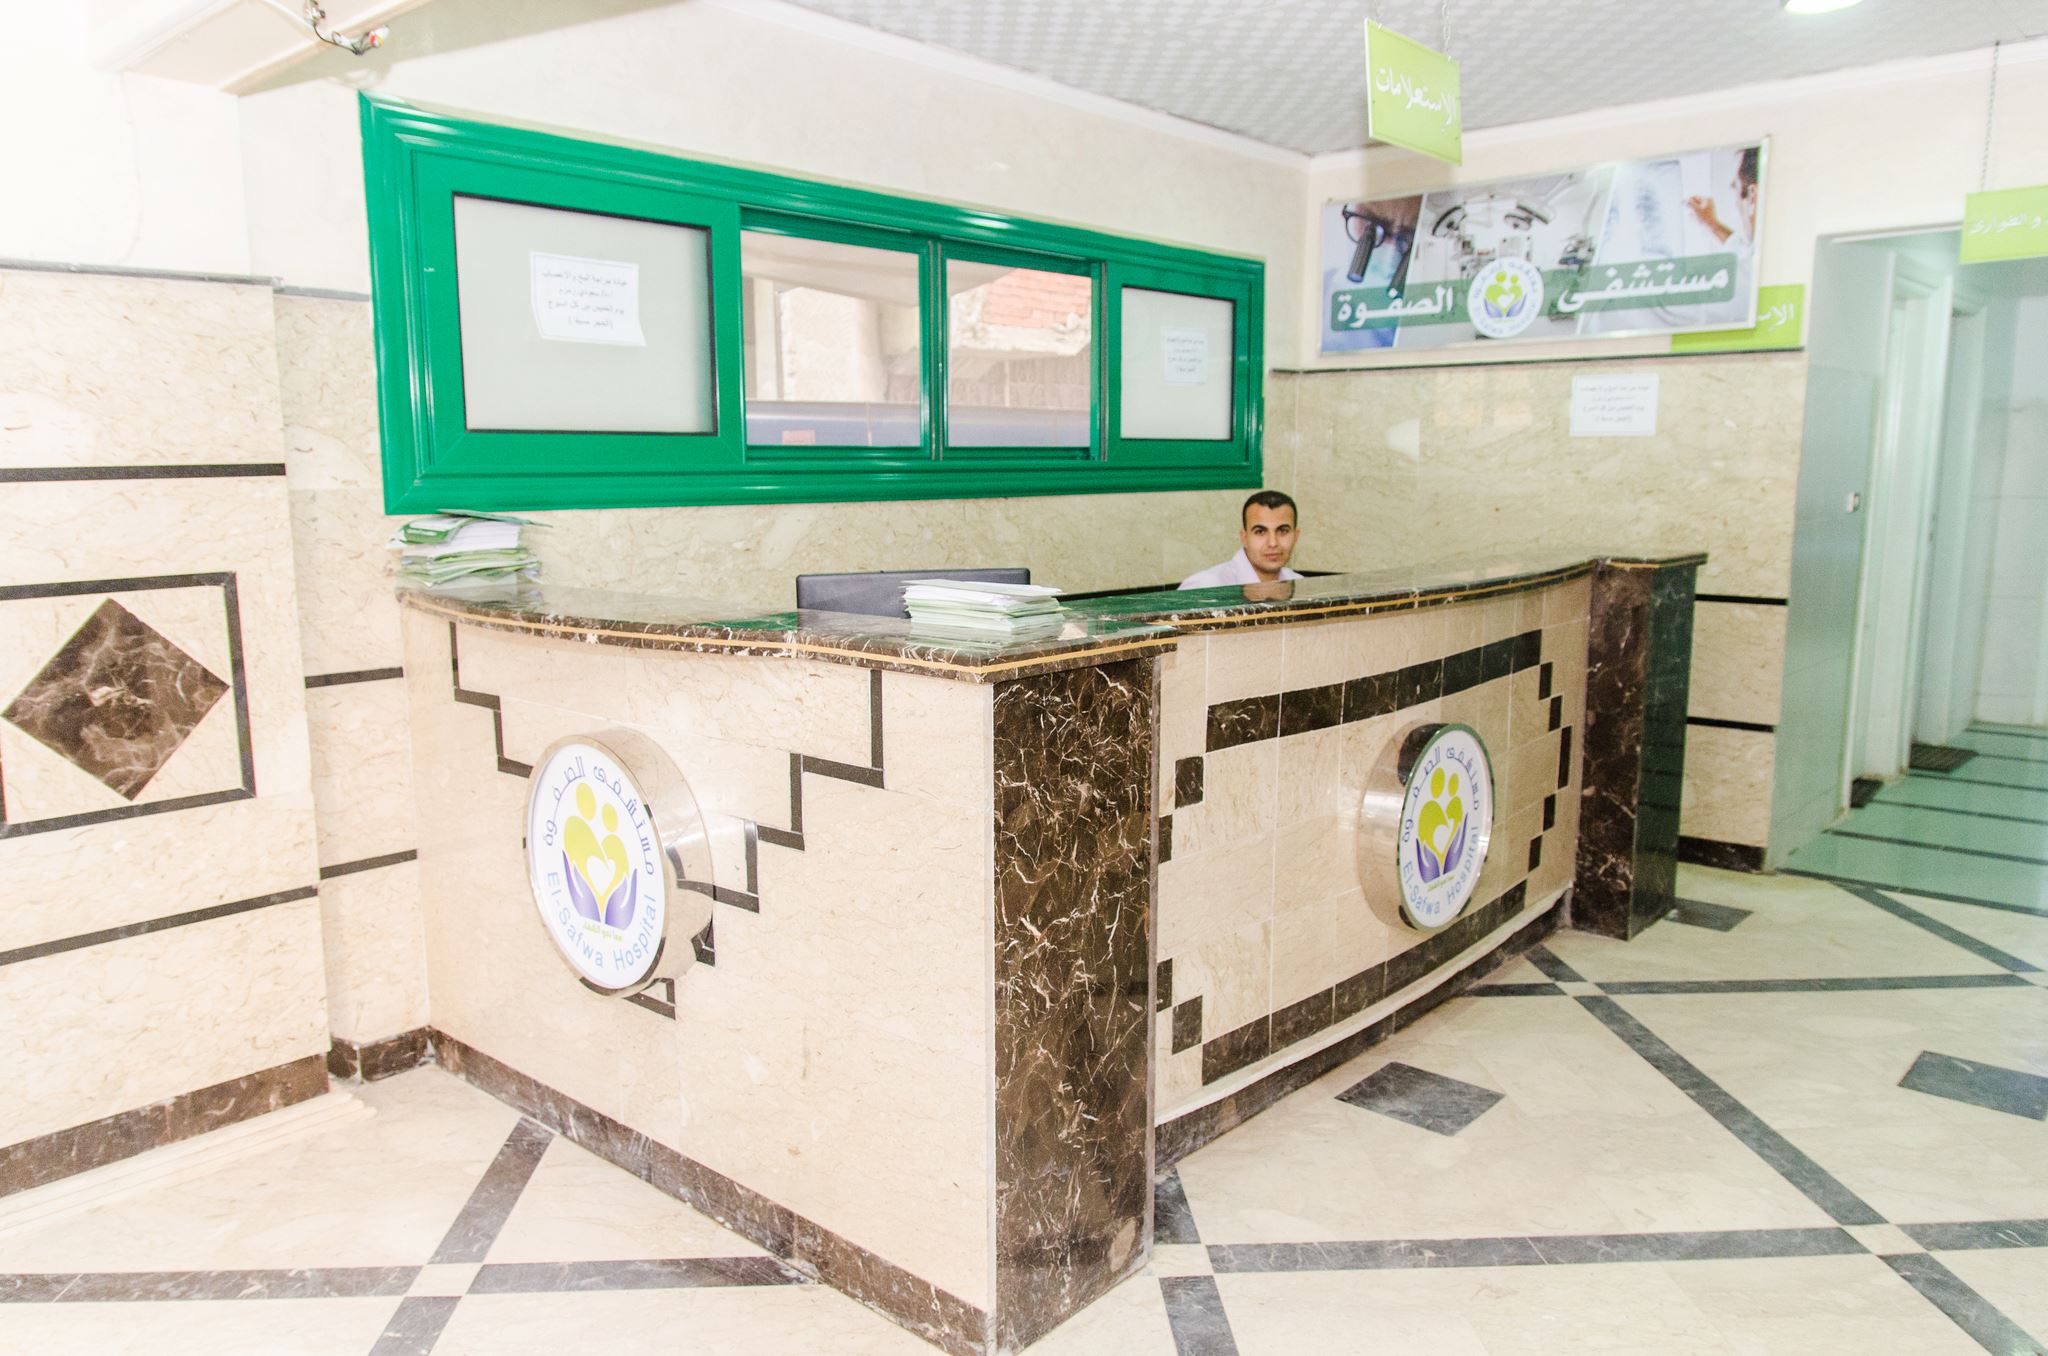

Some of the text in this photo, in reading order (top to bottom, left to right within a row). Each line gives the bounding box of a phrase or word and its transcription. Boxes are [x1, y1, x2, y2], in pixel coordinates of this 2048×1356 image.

[1337, 285, 1453, 328] الصفوة
[1557, 262, 1729, 312] مستشفى
[543, 756, 655, 876] مستشفى الصفوة
[1402, 746, 1441, 843] الصفوة
[1403, 826, 1479, 915] El-Safwa Hospital
[546, 872, 657, 971] El-Safwa Hospital
